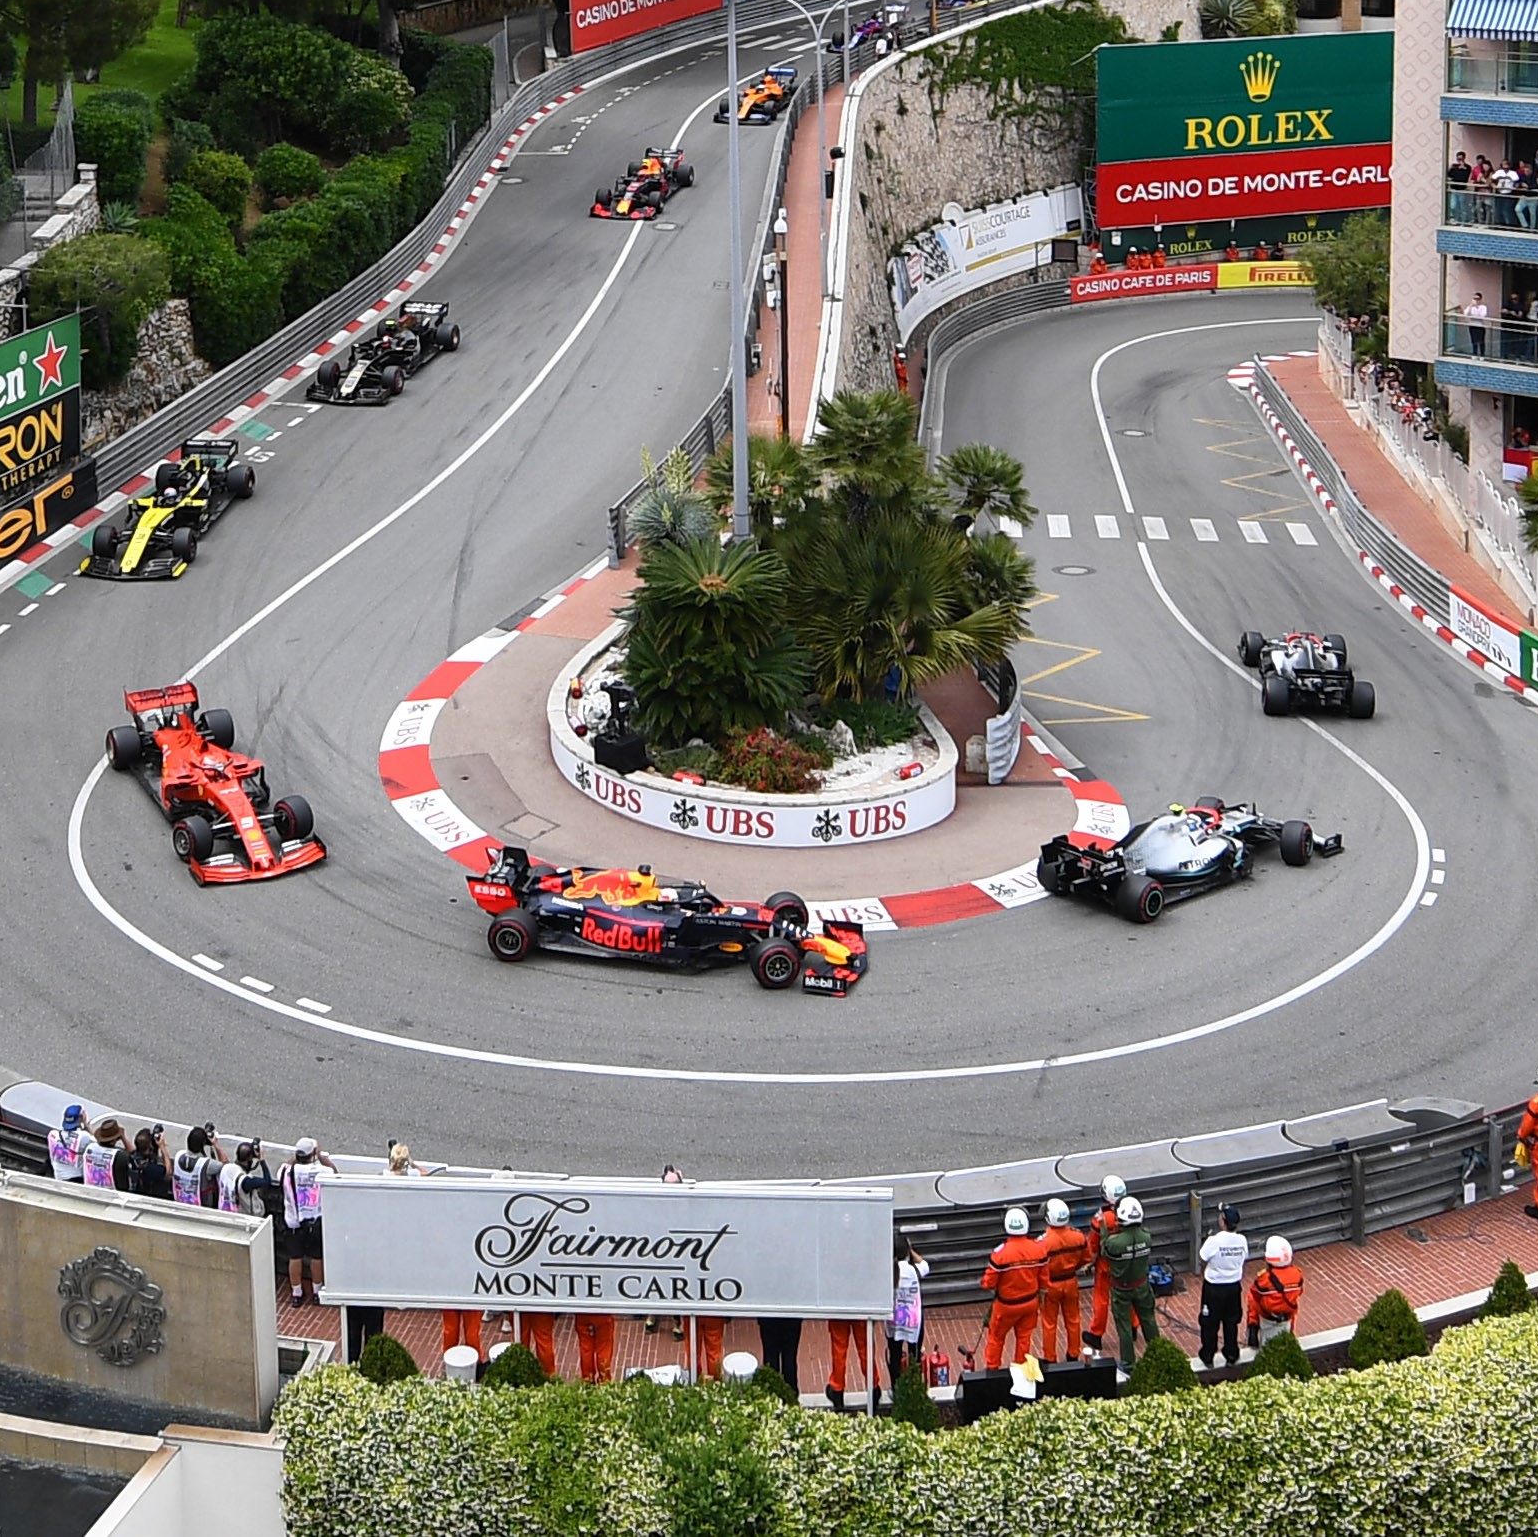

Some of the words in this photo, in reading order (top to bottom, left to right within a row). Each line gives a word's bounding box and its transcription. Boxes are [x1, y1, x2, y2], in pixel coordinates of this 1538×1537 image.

[576, 2, 619, 29] CASINO
[1183, 109, 1334, 150] ROLEX
[1116, 179, 1203, 203] CASINO
[1207, 176, 1240, 196] DE
[1169, 239, 1213, 255] ROLEX
[1287, 229, 1337, 244] ROLEX
[1076, 273, 1120, 296] CASINO
[1122, 271, 1155, 290] CAFE
[1156, 270, 1173, 287] DE
[1174, 270, 1211, 285] PARIS
[1249, 266, 1314, 282] PIRELL
[1, 447, 63, 489] THERAPY
[393, 715, 424, 746] UBS
[594, 774, 642, 814] UBS
[424, 812, 470, 843] UBS
[705, 806, 774, 838] UBS
[848, 800, 907, 838] UBS
[474, 884, 506, 897] ESSO
[814, 904, 884, 924] UBS
[805, 976, 833, 989] Mobil
[474, 1193, 738, 1271] Fairmont
[473, 1271, 603, 1298] MONTE
[617, 1275, 743, 1301] CARLO
